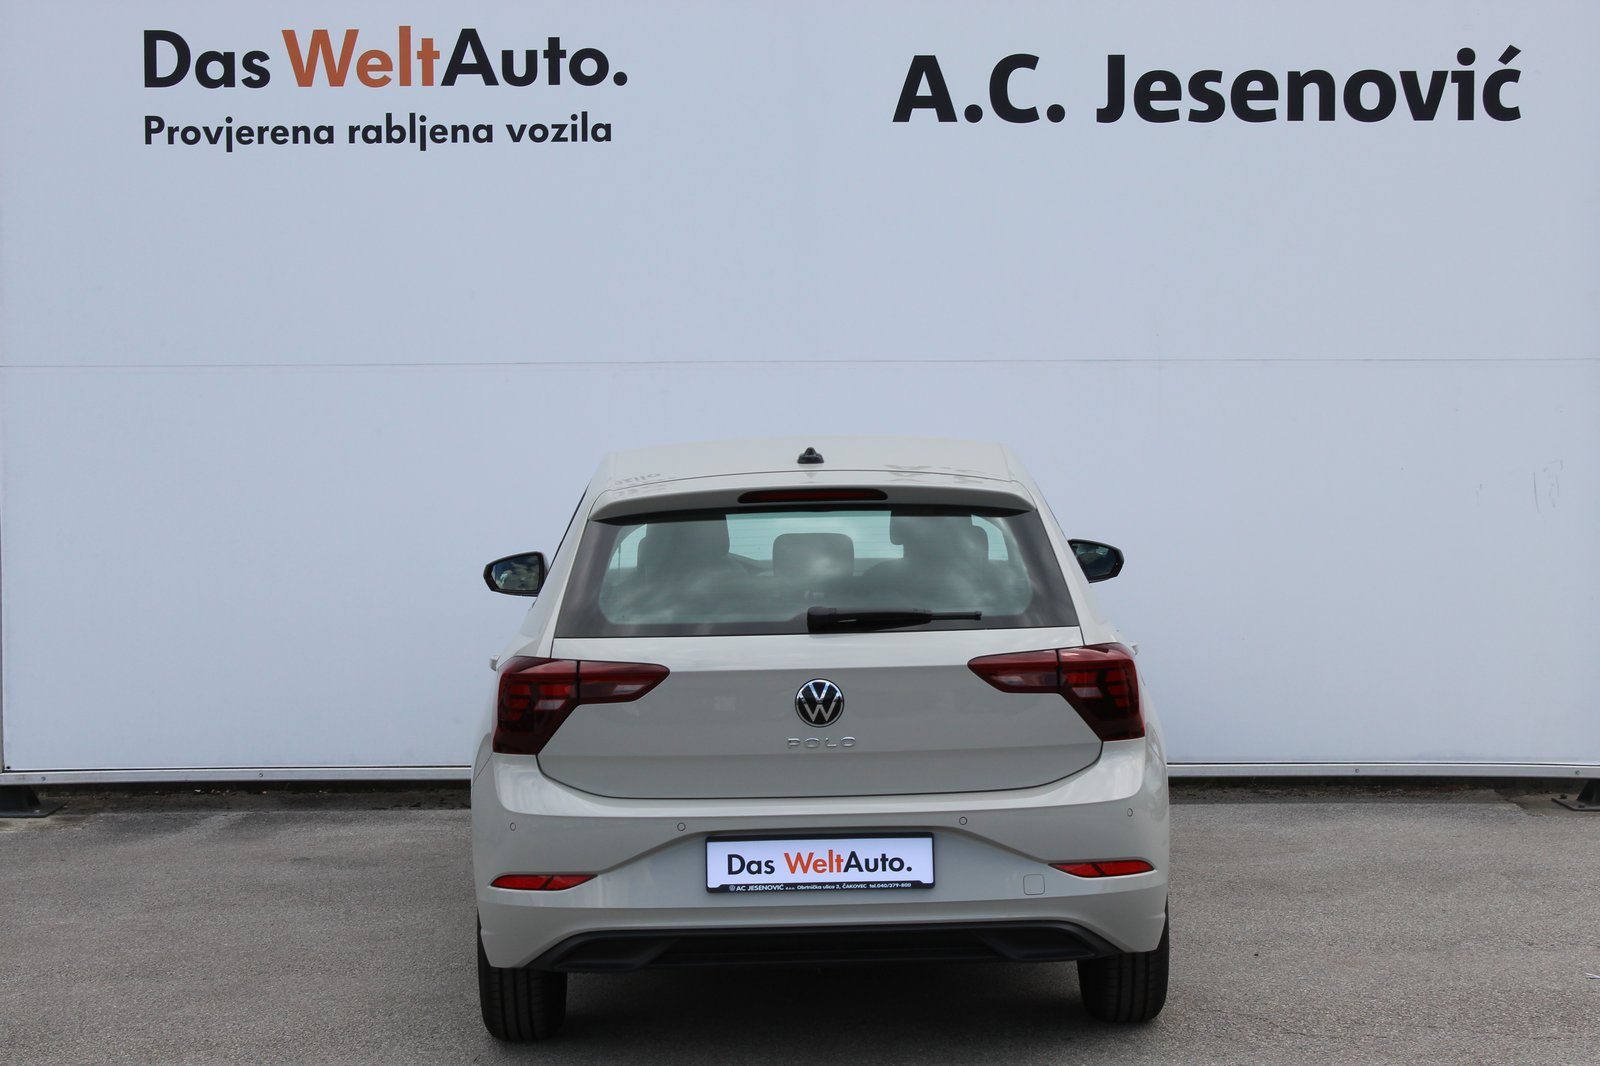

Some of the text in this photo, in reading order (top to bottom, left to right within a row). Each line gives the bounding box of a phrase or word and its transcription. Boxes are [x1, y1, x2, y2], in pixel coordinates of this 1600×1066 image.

[143, 25, 628, 90] Das WeltAuto.
[891, 44, 1523, 124] A.C. Jesenović
[144, 110, 612, 153] Provjerena rabljena vozila
[787, 736, 857, 749] POLO
[727, 849, 913, 876] Das WeltAuto.
[747, 883, 785, 892] JESENOVIĆ
